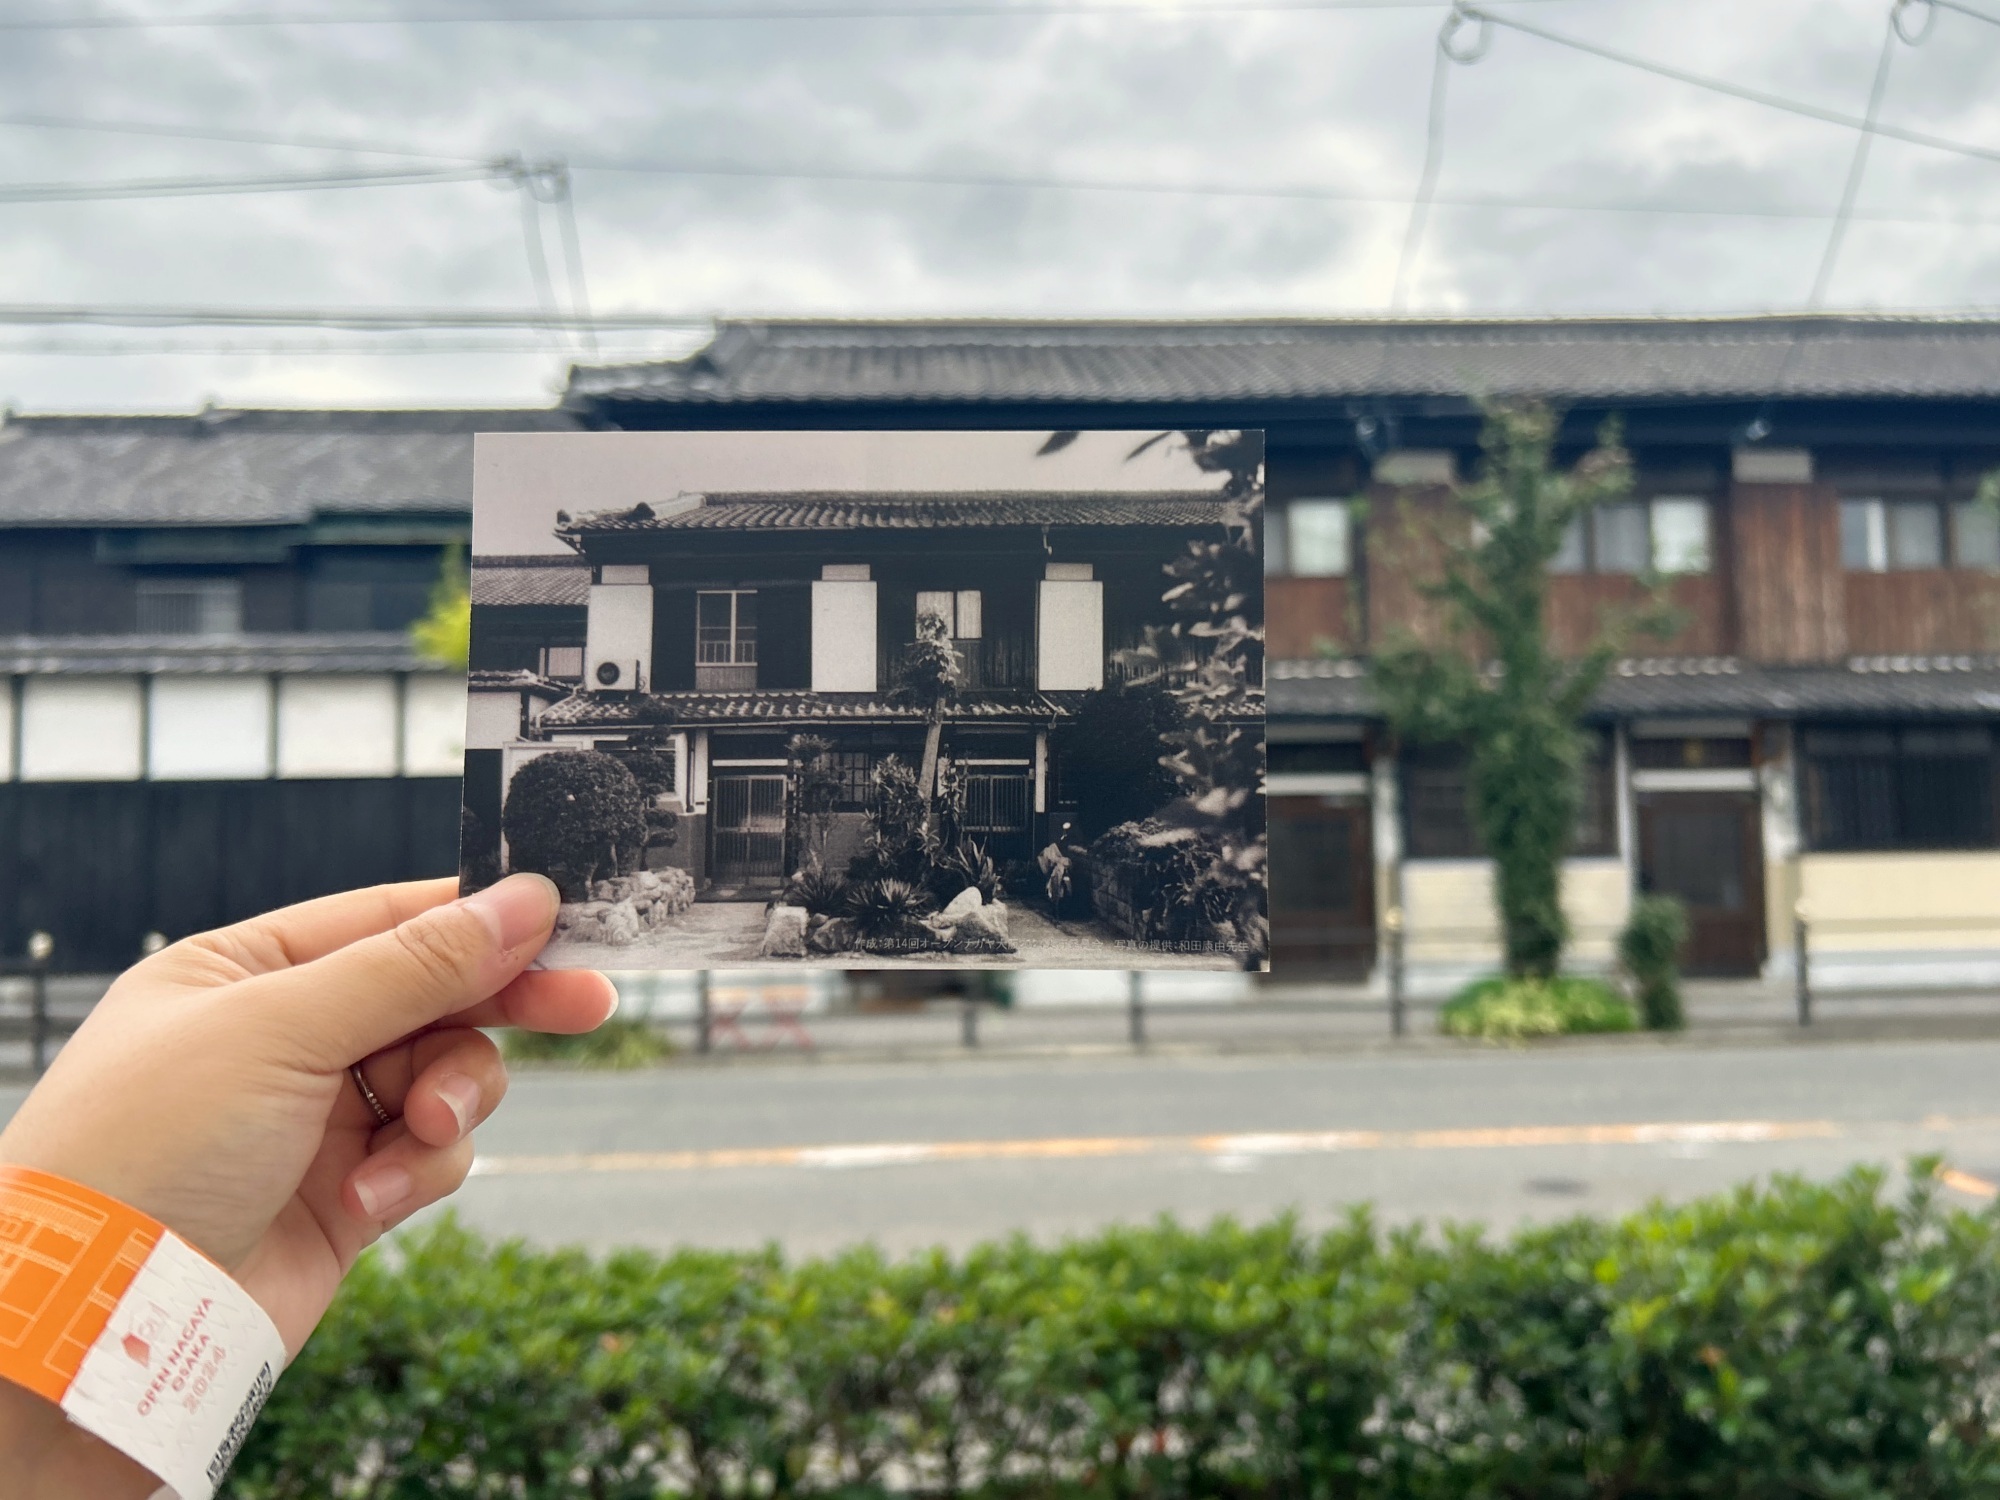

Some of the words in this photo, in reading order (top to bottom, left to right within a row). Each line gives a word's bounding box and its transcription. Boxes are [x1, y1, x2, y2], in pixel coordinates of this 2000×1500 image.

[137, 1366, 171, 1416] OPEN
[168, 1298, 213, 1365] NAGAYA
[171, 1334, 210, 1392] OSAKA
[183, 1345, 226, 1415] 2024
